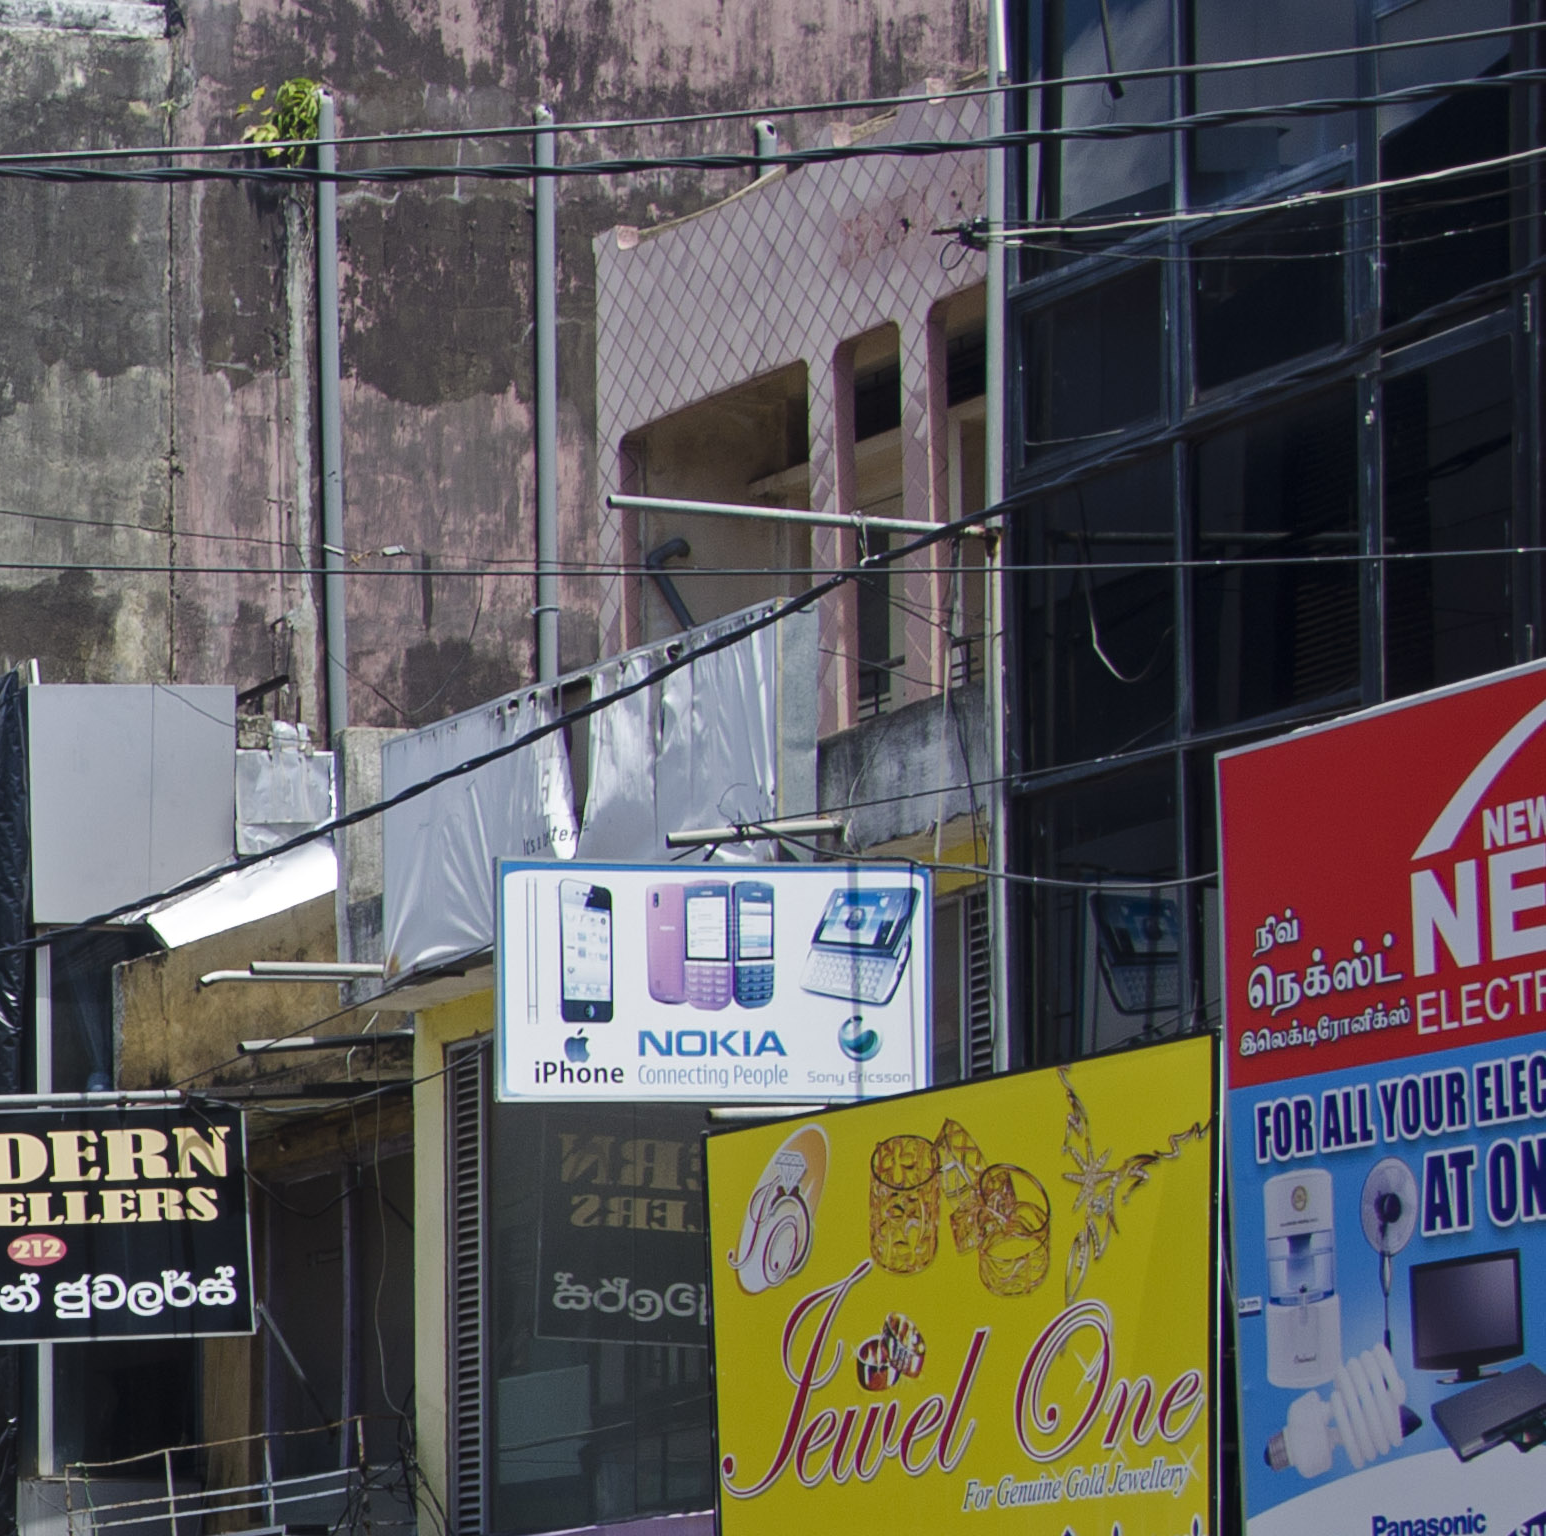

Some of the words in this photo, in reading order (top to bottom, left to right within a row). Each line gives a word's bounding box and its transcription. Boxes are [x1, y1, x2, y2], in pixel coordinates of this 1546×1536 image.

[638, 1029, 787, 1057] NOKIA
[534, 1060, 624, 1085] iPhone
[637, 1063, 729, 1088] Connecting
[733, 1063, 788, 1089] People
[807, 1070, 844, 1086] Sony
[848, 1069, 912, 1084] Ericsson
[1255, 1095, 1317, 1164] FOR
[1320, 1084, 1376, 1153] ALL
[1377, 1067, 1469, 1142] YOUR
[1421, 1145, 1478, 1238] AT
[11, 1239, 62, 1260] 212
[722, 1258, 992, 1501] Jewel
[1014, 1299, 1206, 1463] One
[962, 1479, 992, 1511] For
[995, 1472, 1062, 1507] Genuine
[1065, 1467, 1107, 1498] Gold
[1108, 1457, 1189, 1497] Jewellery
